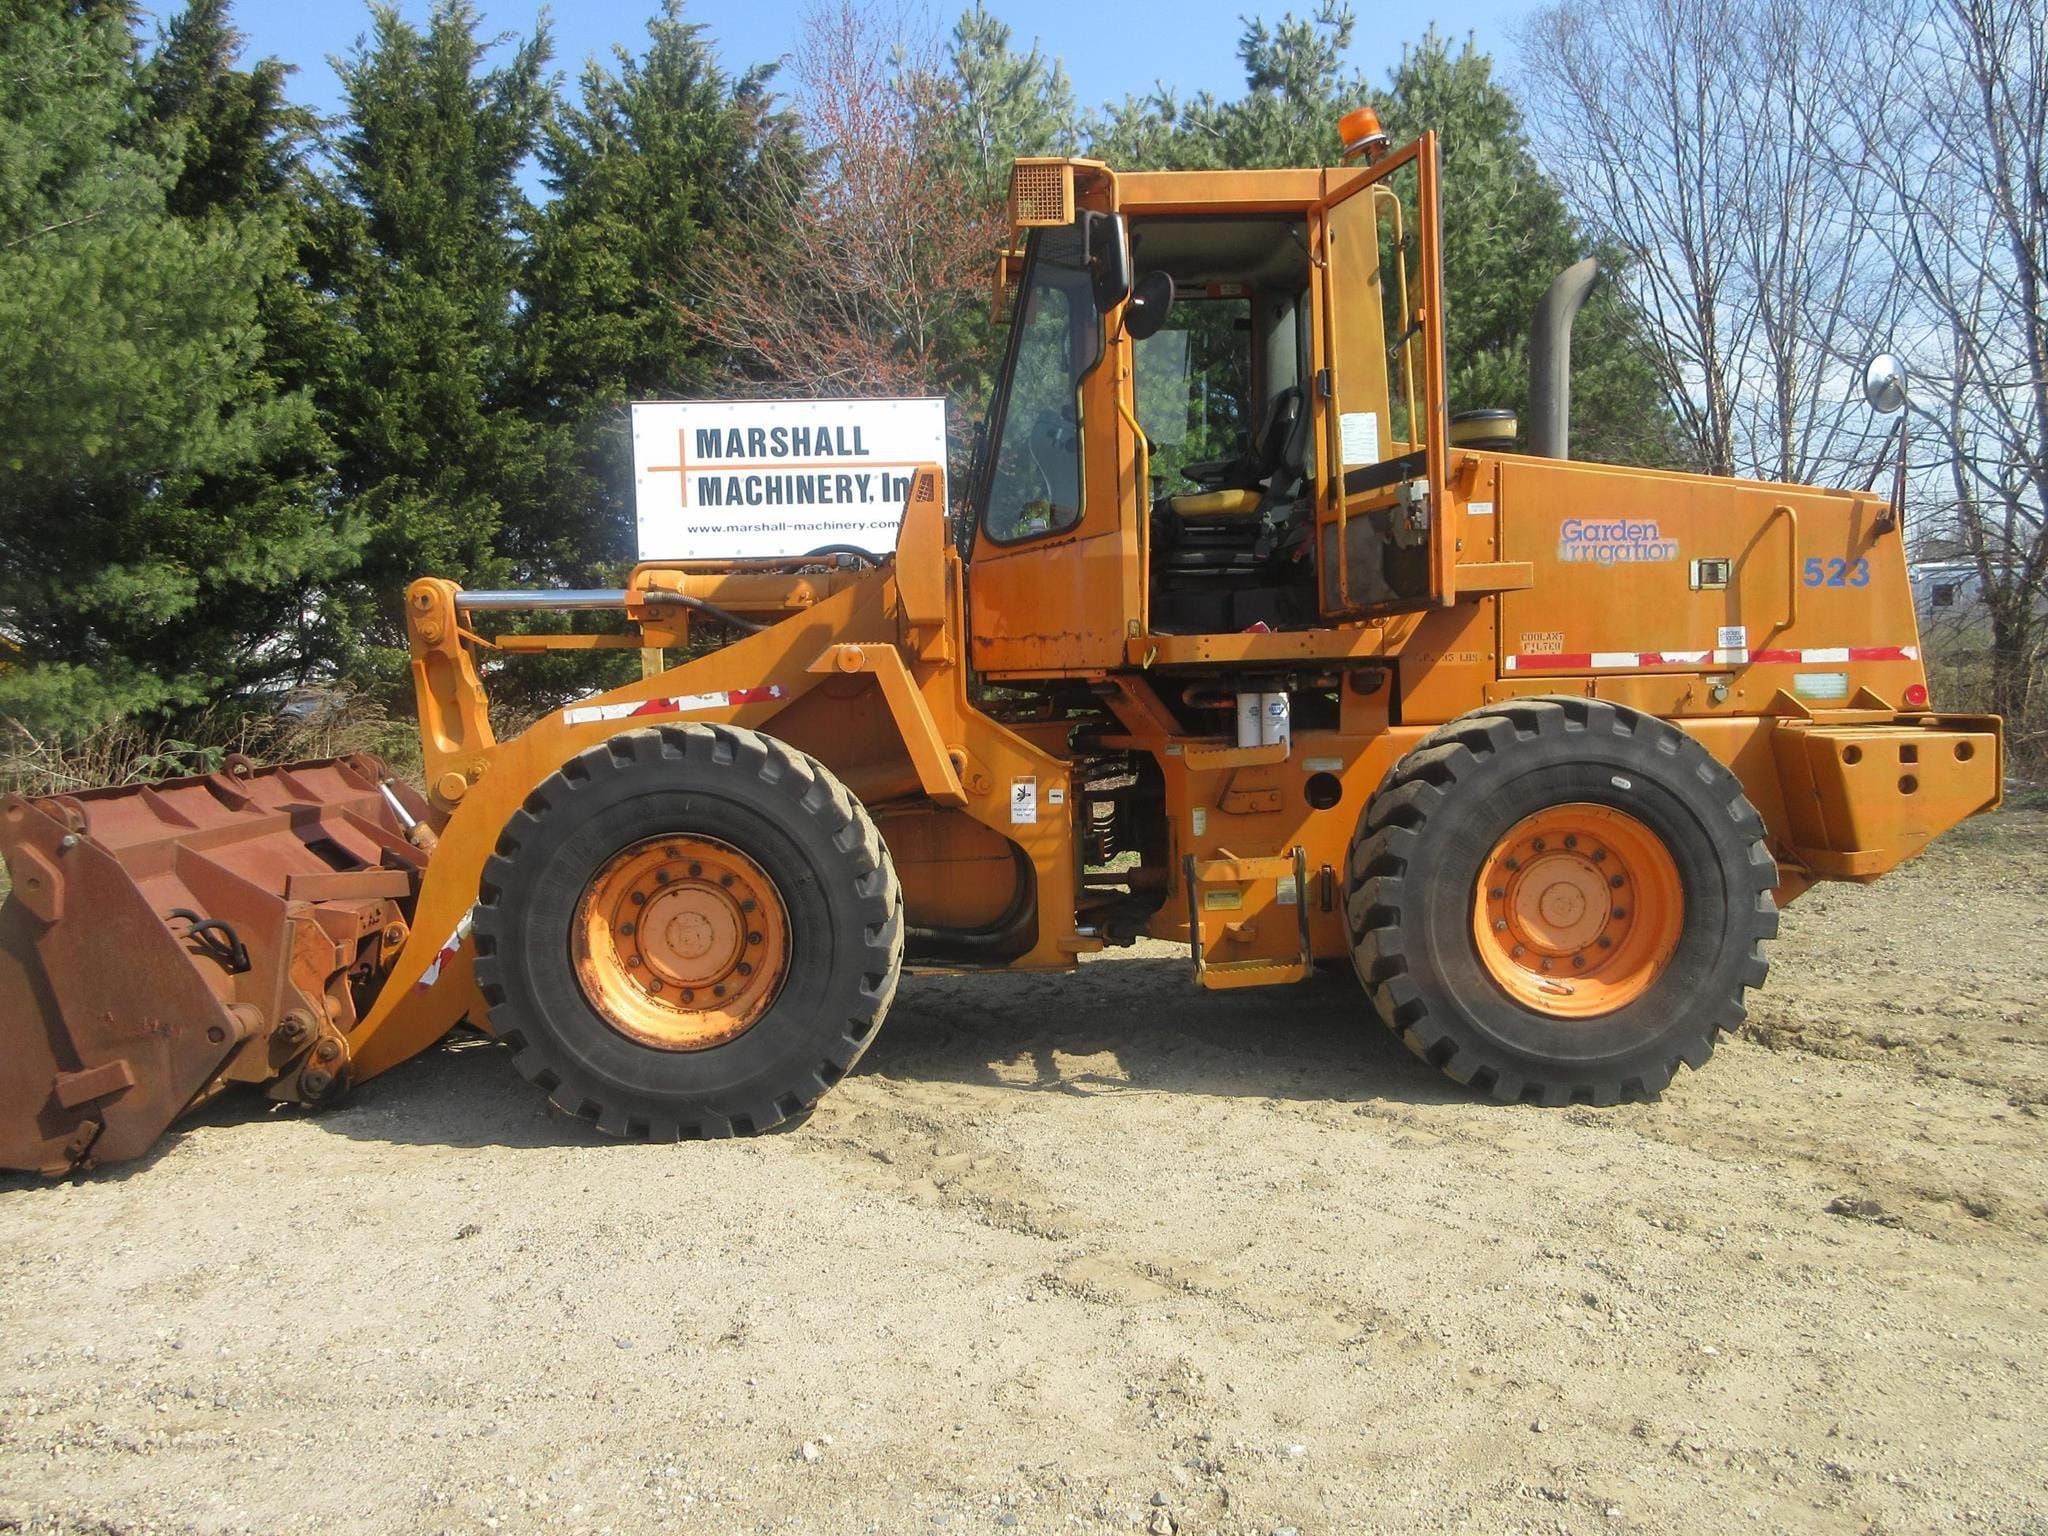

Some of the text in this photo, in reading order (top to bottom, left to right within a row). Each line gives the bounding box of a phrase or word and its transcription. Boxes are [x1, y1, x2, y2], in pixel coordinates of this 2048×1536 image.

[696, 426, 869, 459] MARSHALL
[698, 472, 910, 506] MACHINERY, In
[687, 520, 900, 534] www.marshall-machinery.com
[1561, 519, 1659, 544] Garden
[1802, 557, 1870, 588] 523
[1521, 632, 1563, 641] COOLANT
[1523, 642, 1561, 651] FILTER
